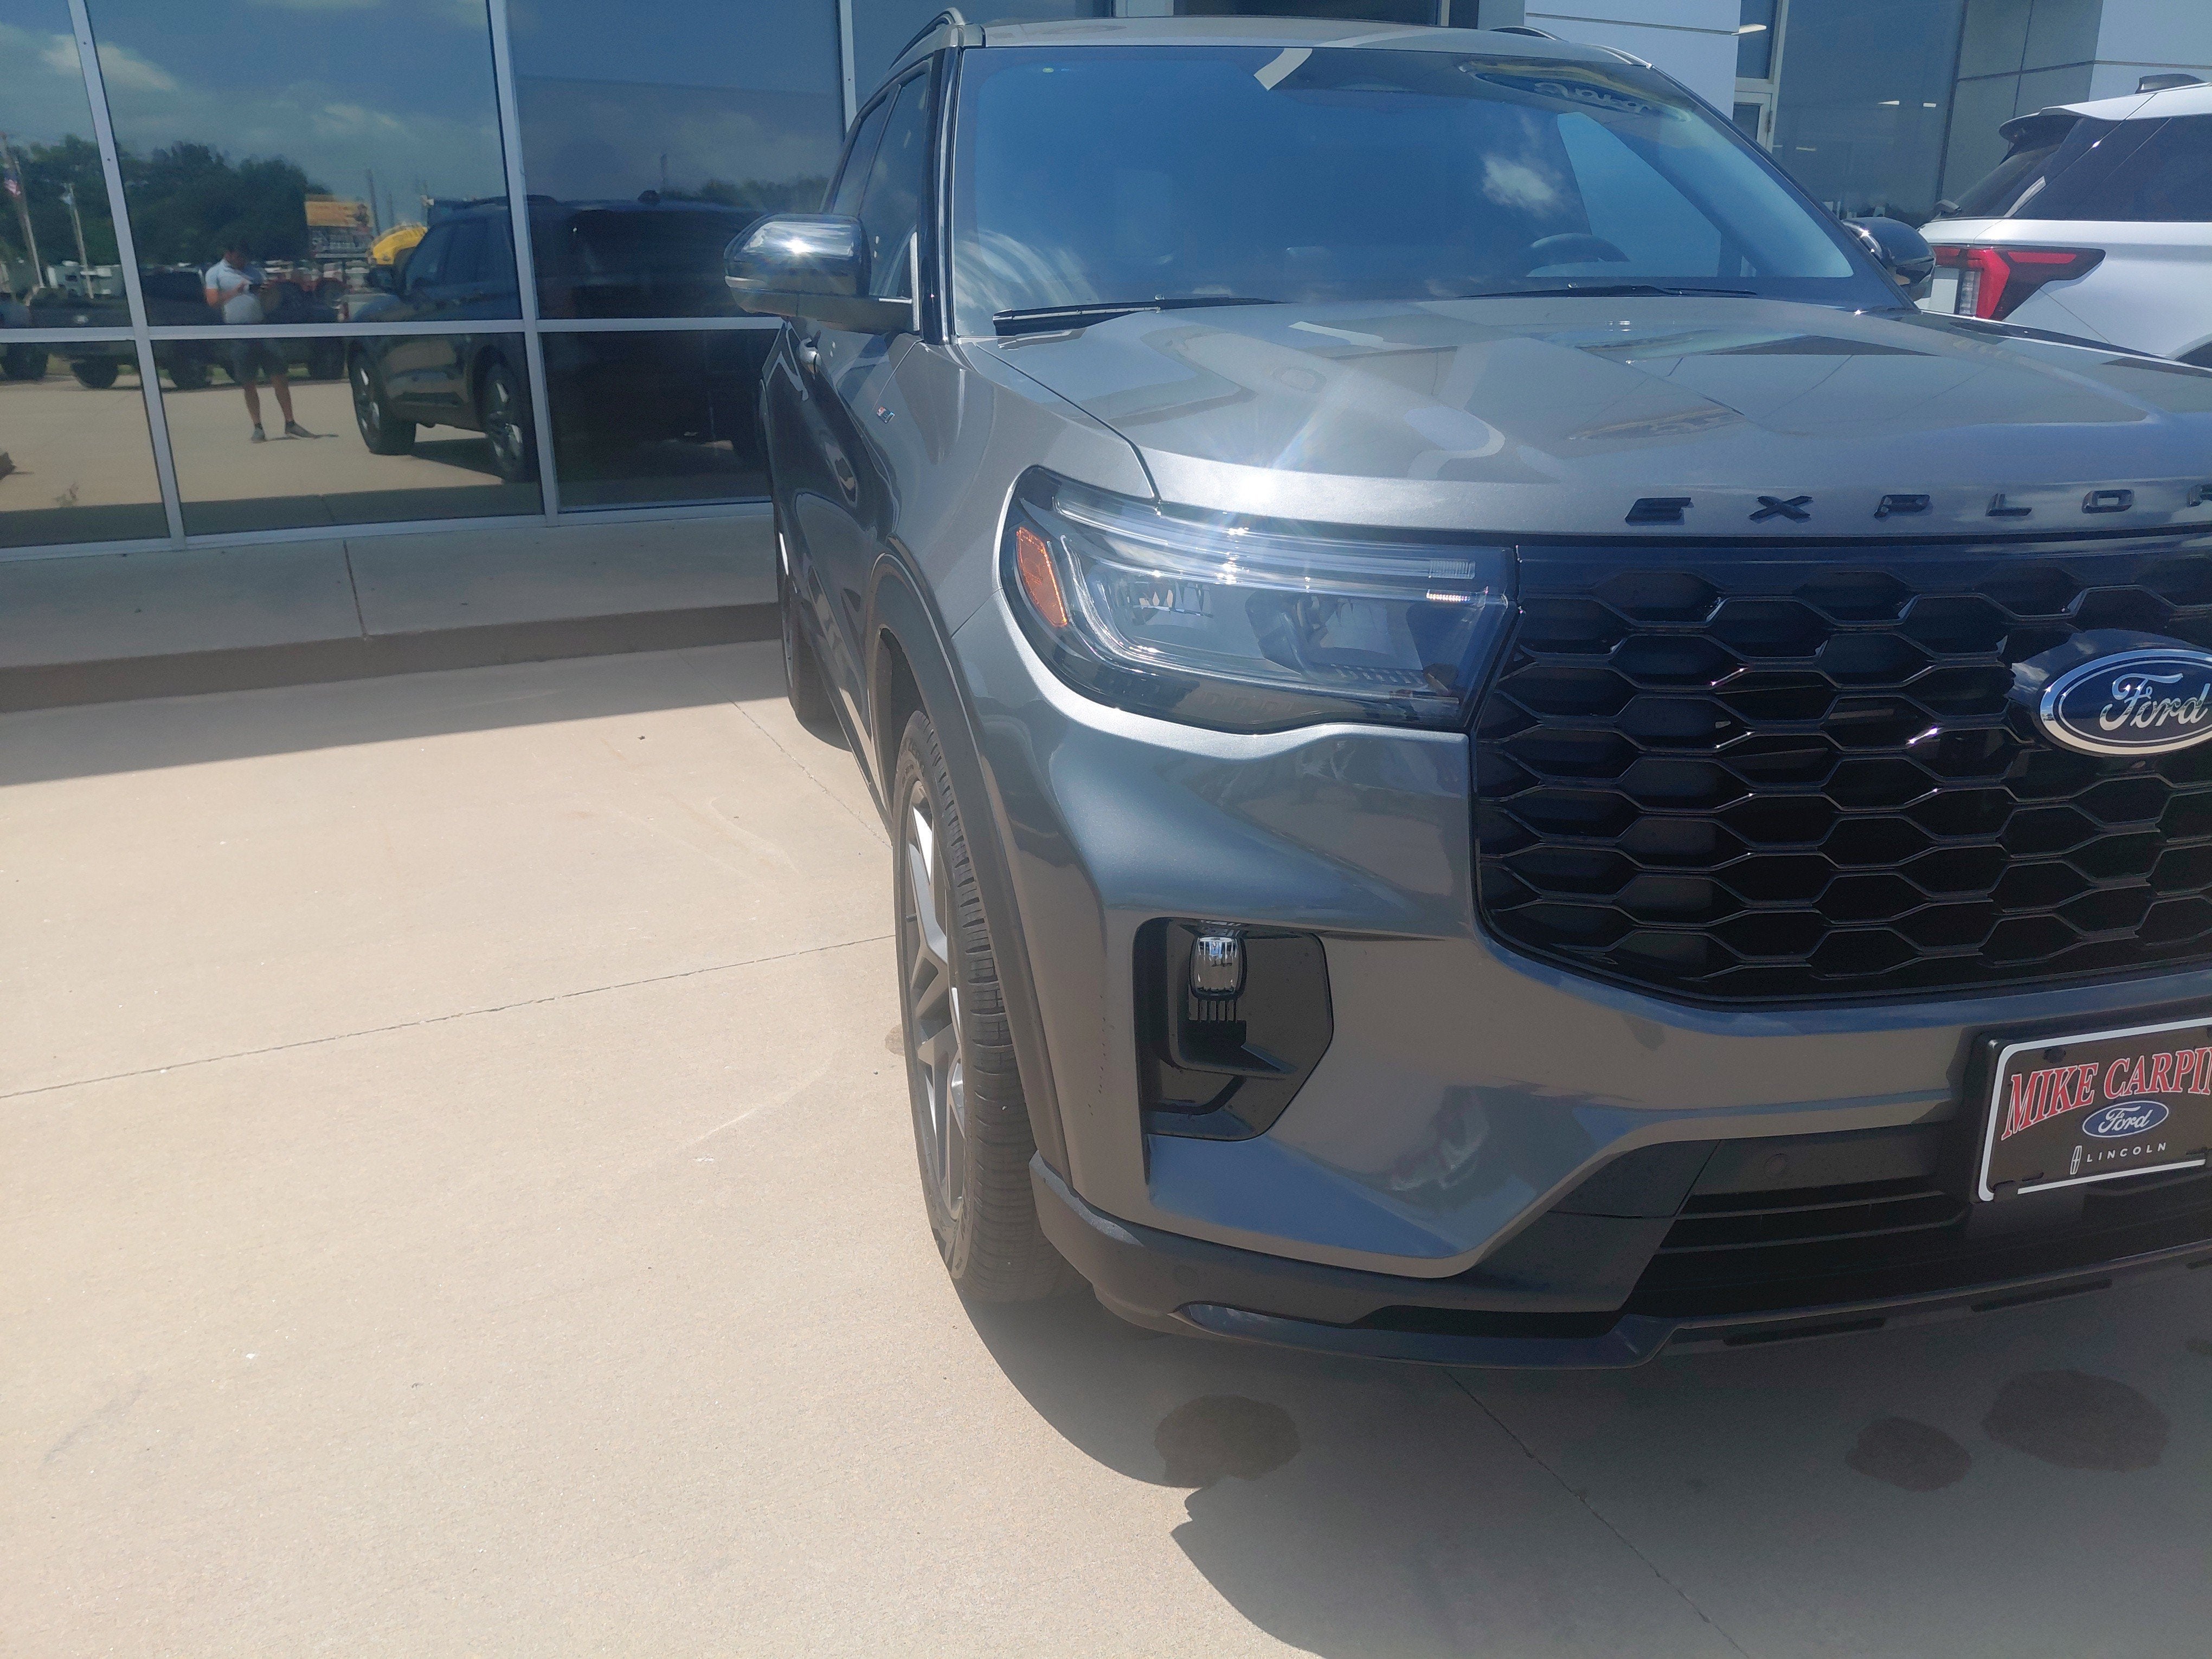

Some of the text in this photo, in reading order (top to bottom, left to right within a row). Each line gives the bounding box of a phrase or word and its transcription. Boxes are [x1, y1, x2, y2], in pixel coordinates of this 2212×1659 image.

[2100, 673, 2211, 731] Ford
[2001, 1062, 2099, 1141] MIKE
[2098, 1105, 2153, 1133] Ford
[2086, 1142, 2167, 1163] LINCOLN
